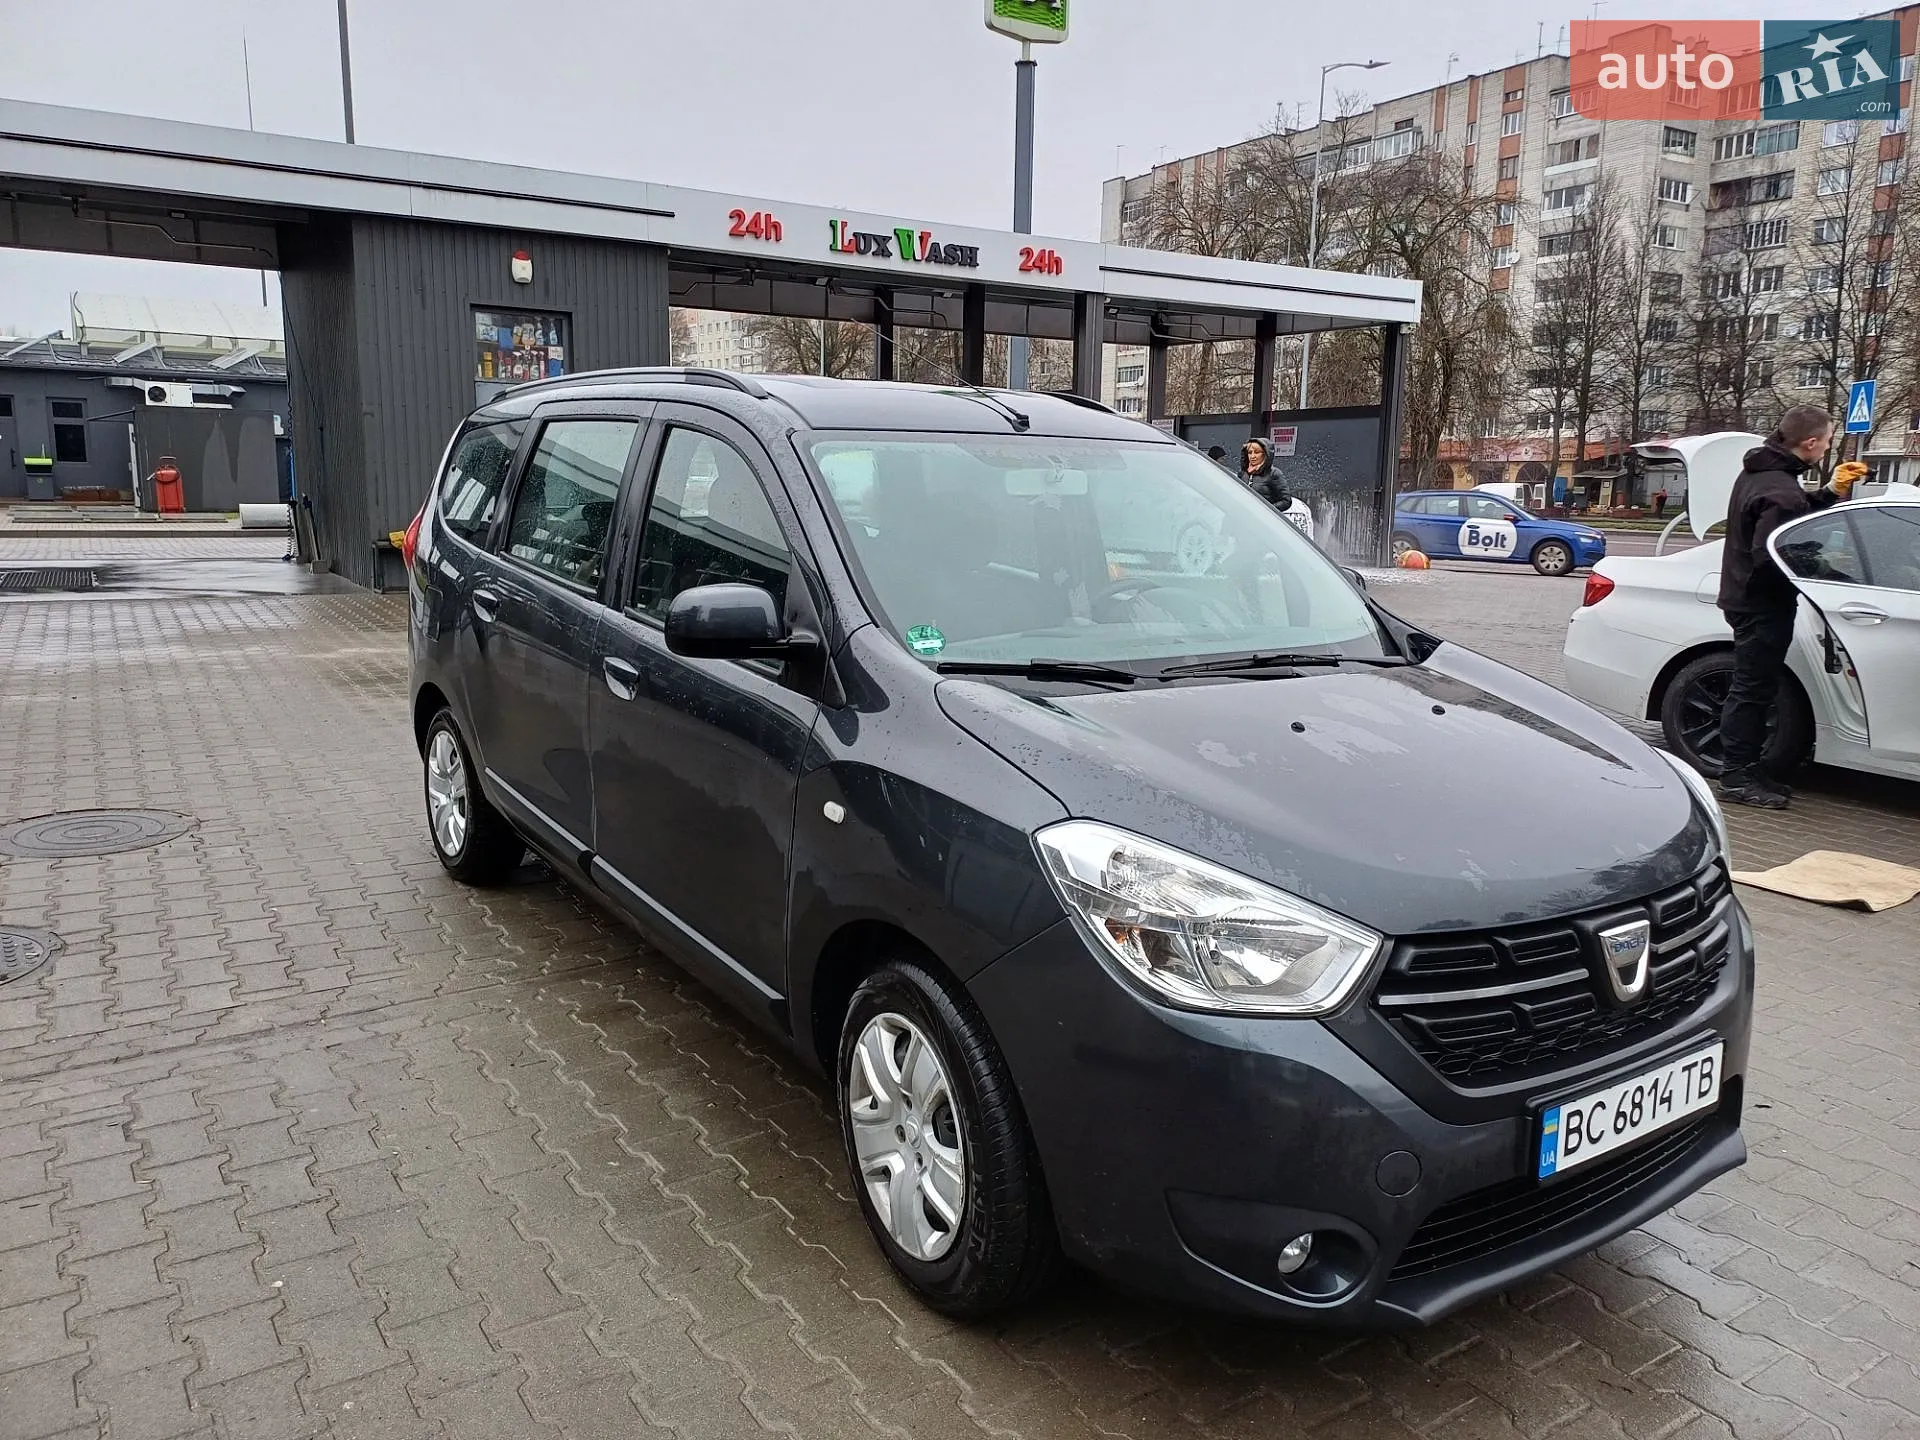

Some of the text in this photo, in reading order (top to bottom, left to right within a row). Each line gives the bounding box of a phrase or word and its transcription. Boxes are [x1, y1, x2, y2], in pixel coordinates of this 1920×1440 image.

[728, 208, 783, 242] 24h
[1018, 247, 1064, 276] 24h
[1467, 529, 1507, 550] Bolt
[1563, 1056, 1714, 1157] BC 6814 TB
[1541, 1153, 1556, 1167] UA
